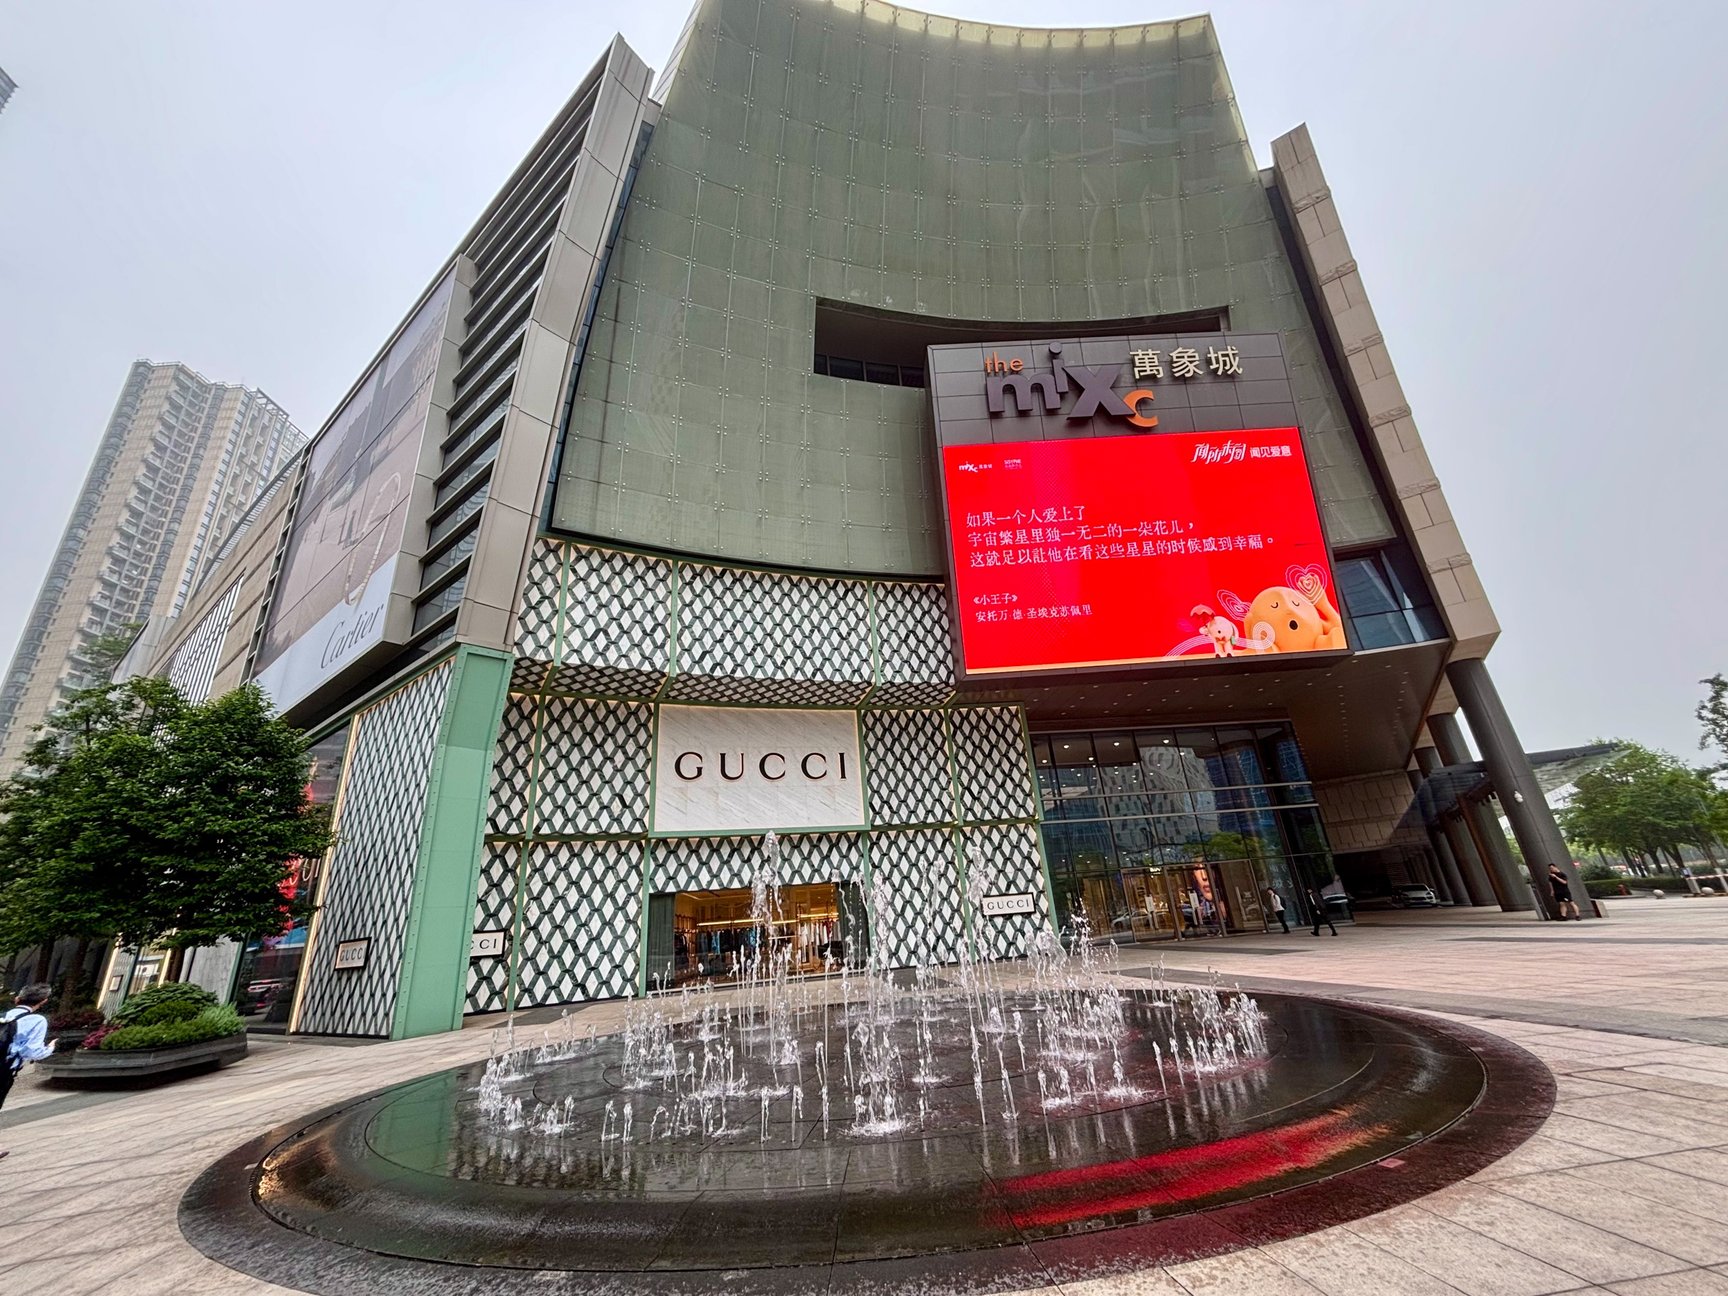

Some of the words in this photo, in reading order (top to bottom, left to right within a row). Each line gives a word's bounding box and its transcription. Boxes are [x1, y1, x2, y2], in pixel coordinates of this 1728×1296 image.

[985, 352, 1024, 373] the
[1130, 345, 1243, 380] 萬象城
[966, 505, 1085, 528] 如果一个人爱上了
[320, 603, 384, 669] Cartier
[674, 751, 847, 781] GUCCI
[986, 899, 1030, 911] GUCCI
[339, 947, 365, 962] GUCC
